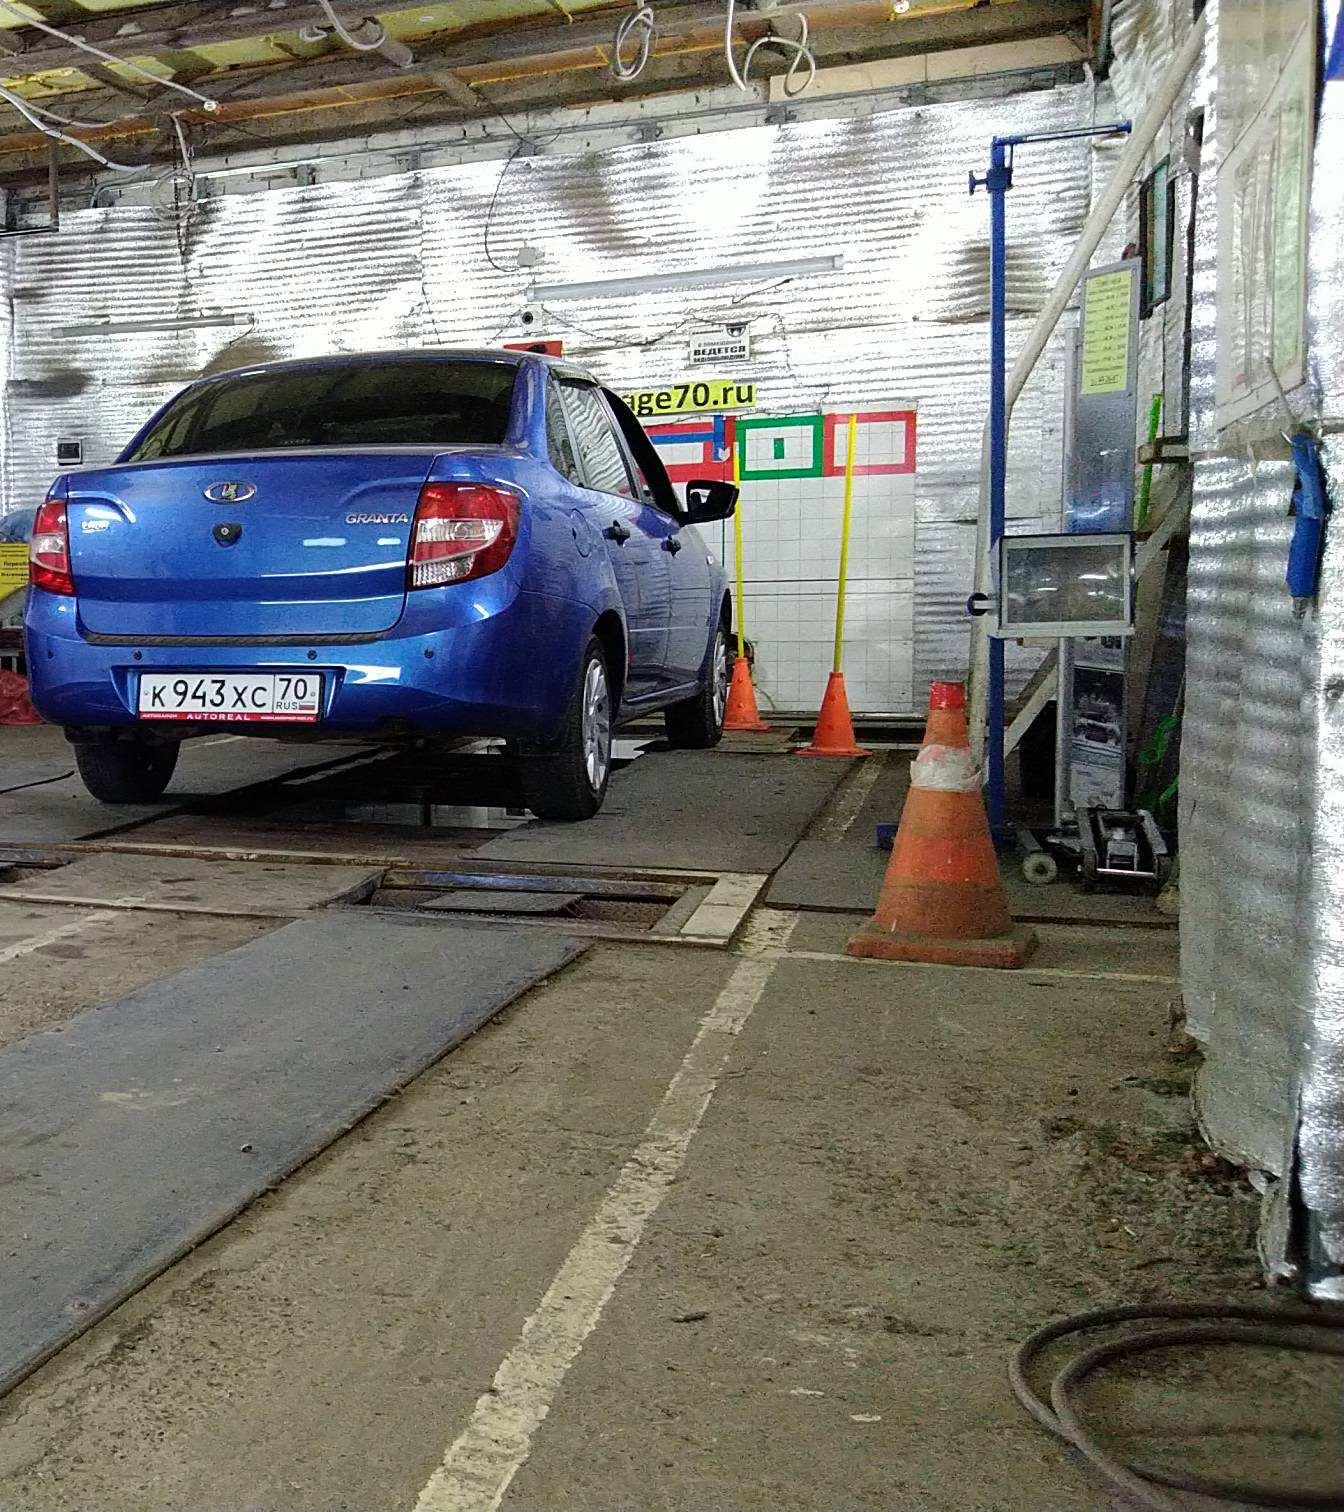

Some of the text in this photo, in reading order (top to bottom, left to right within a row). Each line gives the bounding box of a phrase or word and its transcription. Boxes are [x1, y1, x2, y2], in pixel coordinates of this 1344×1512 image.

[693, 345, 746, 356] ВЕДЕТСЯ
[346, 513, 409, 524] GRANTA
[278, 678, 308, 700] 70
[276, 701, 298, 711] RUS
[186, 713, 251, 721] AUTOREAL
